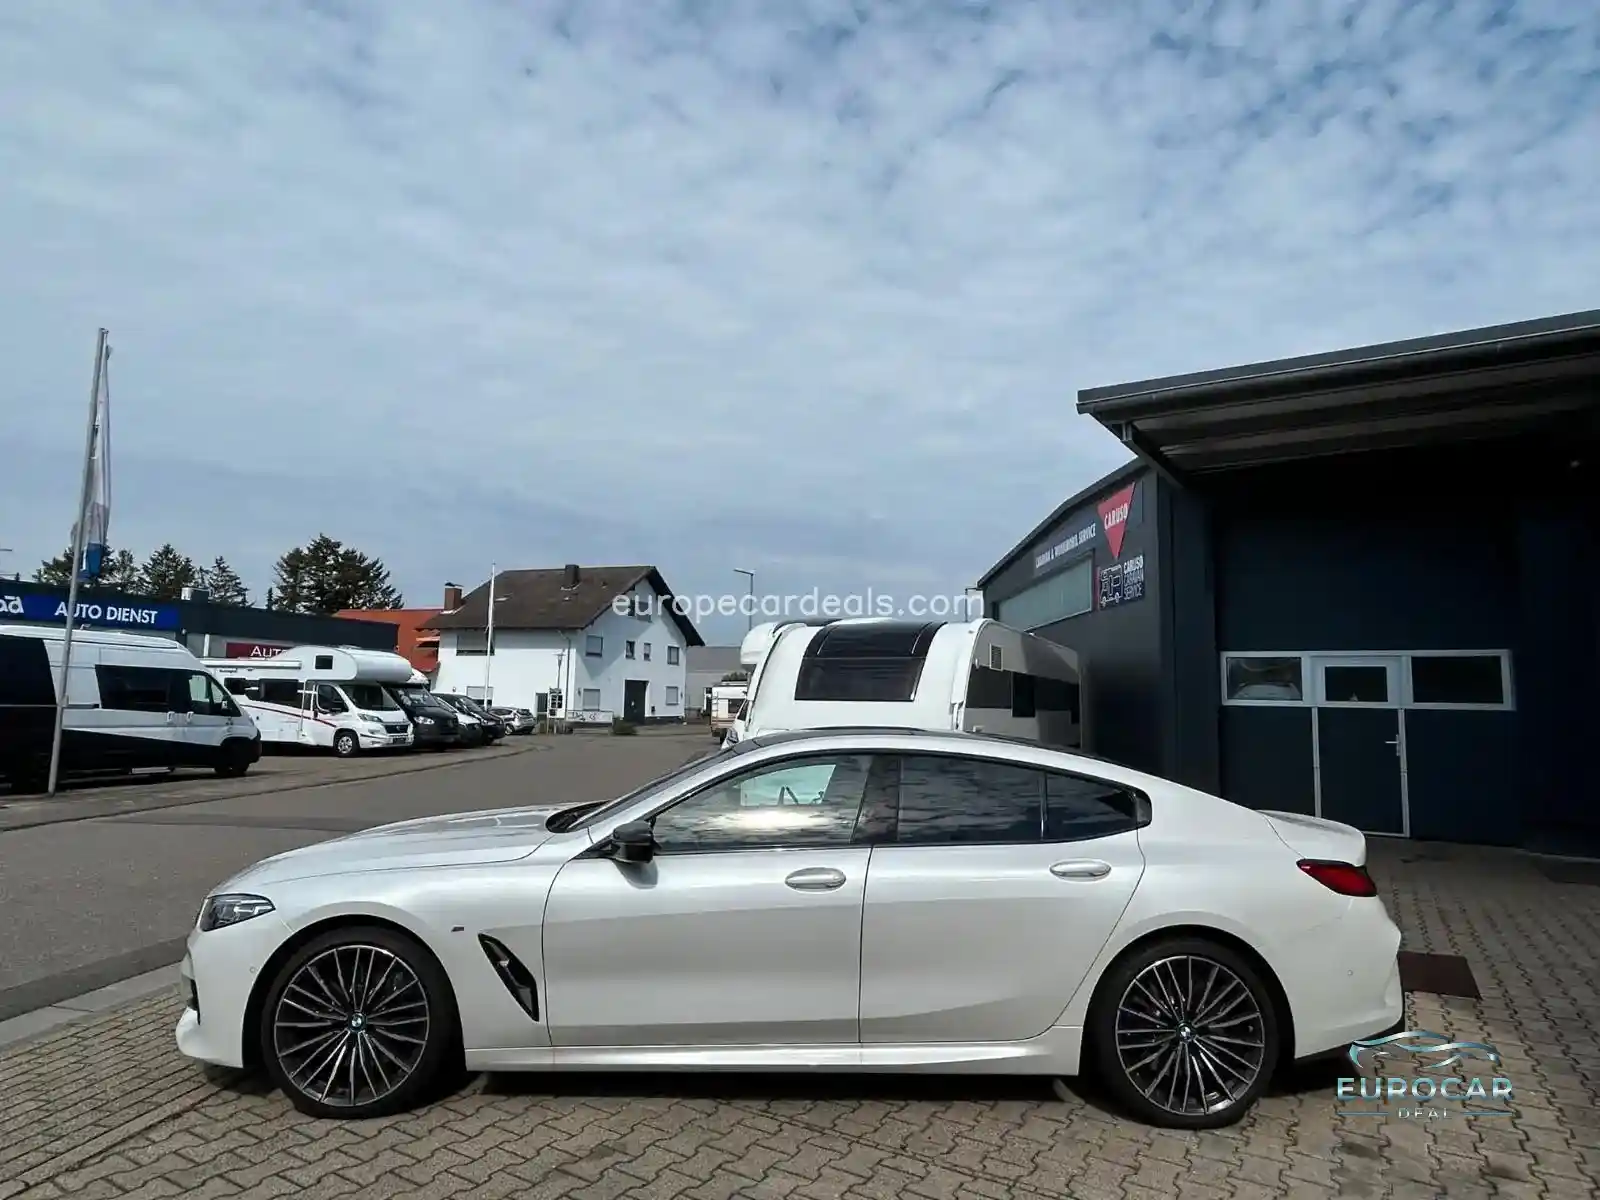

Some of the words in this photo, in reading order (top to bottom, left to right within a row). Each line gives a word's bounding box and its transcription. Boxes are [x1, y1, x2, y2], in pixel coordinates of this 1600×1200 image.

[1104, 503, 1128, 530] CARUSO
[1123, 555, 1144, 575] CARUSO
[106, 606, 158, 624] DIENST
